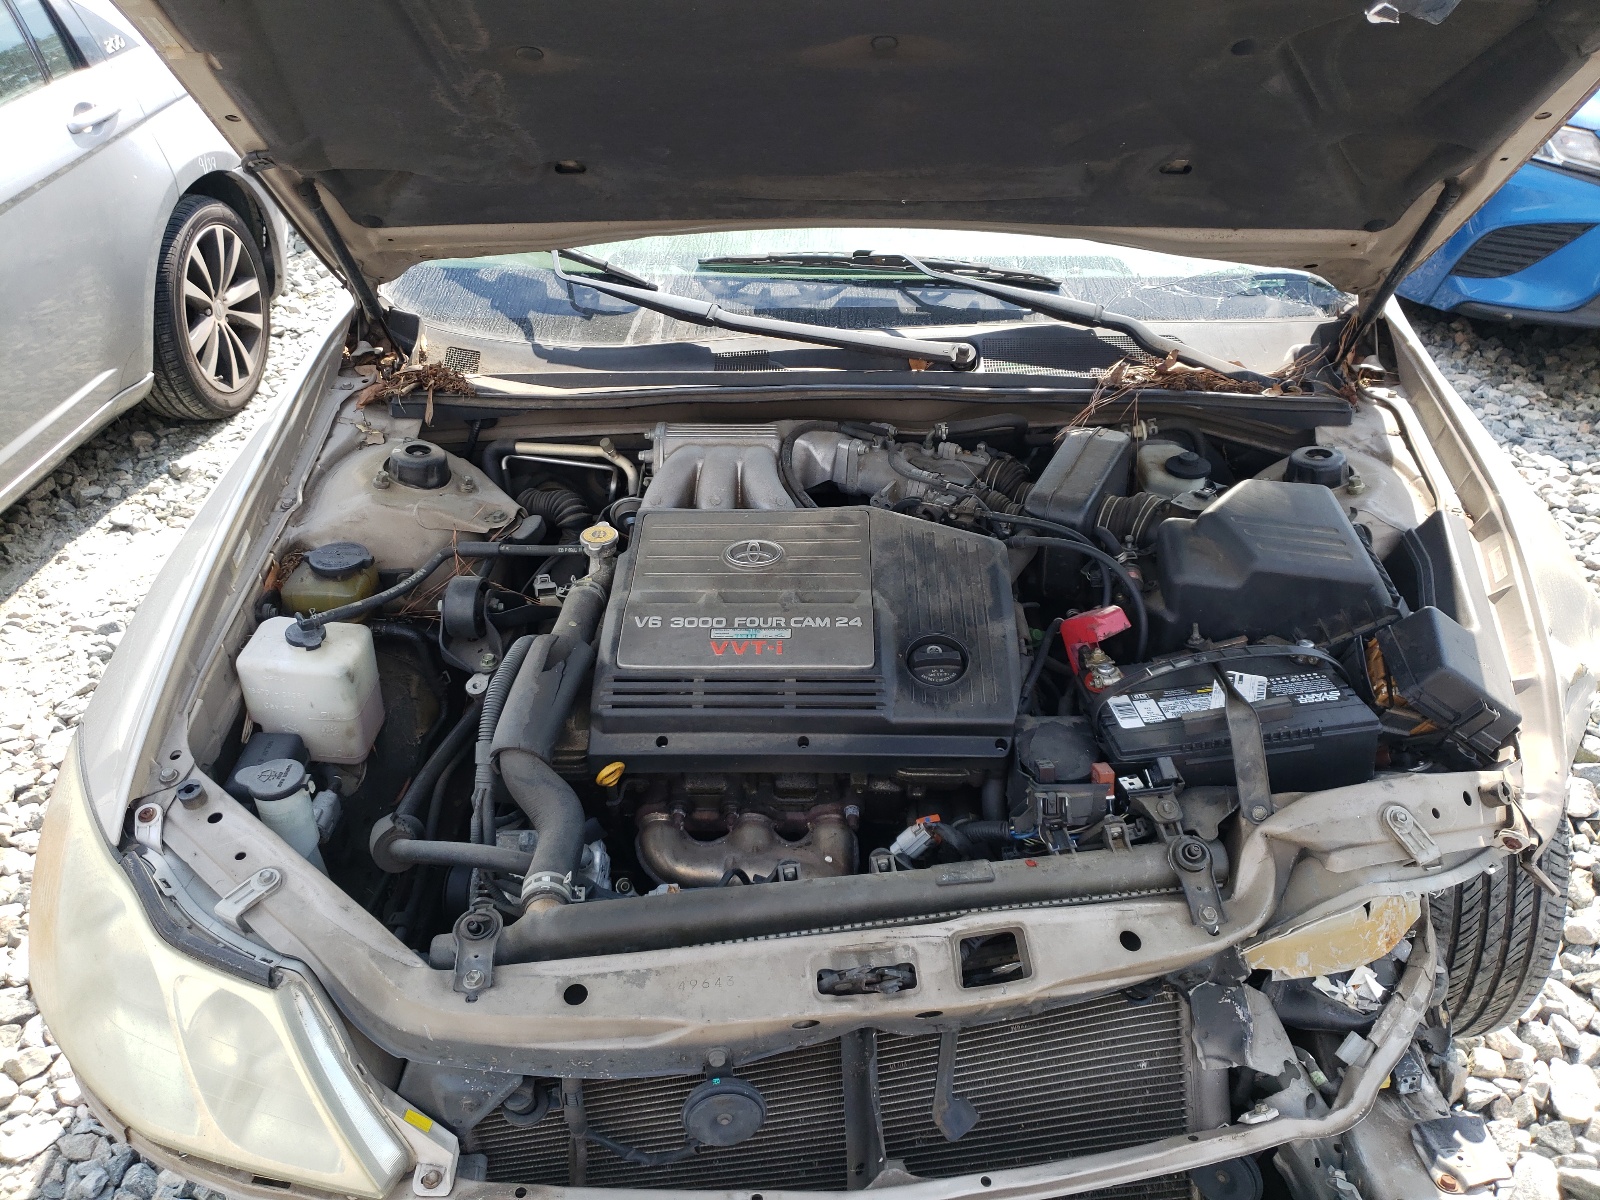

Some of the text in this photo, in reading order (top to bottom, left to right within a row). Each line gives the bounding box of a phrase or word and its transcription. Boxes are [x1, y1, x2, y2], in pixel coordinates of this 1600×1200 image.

[635, 616, 863, 628] V6 3000 FOUR CAM 24
[678, 975, 735, 991] 49643
